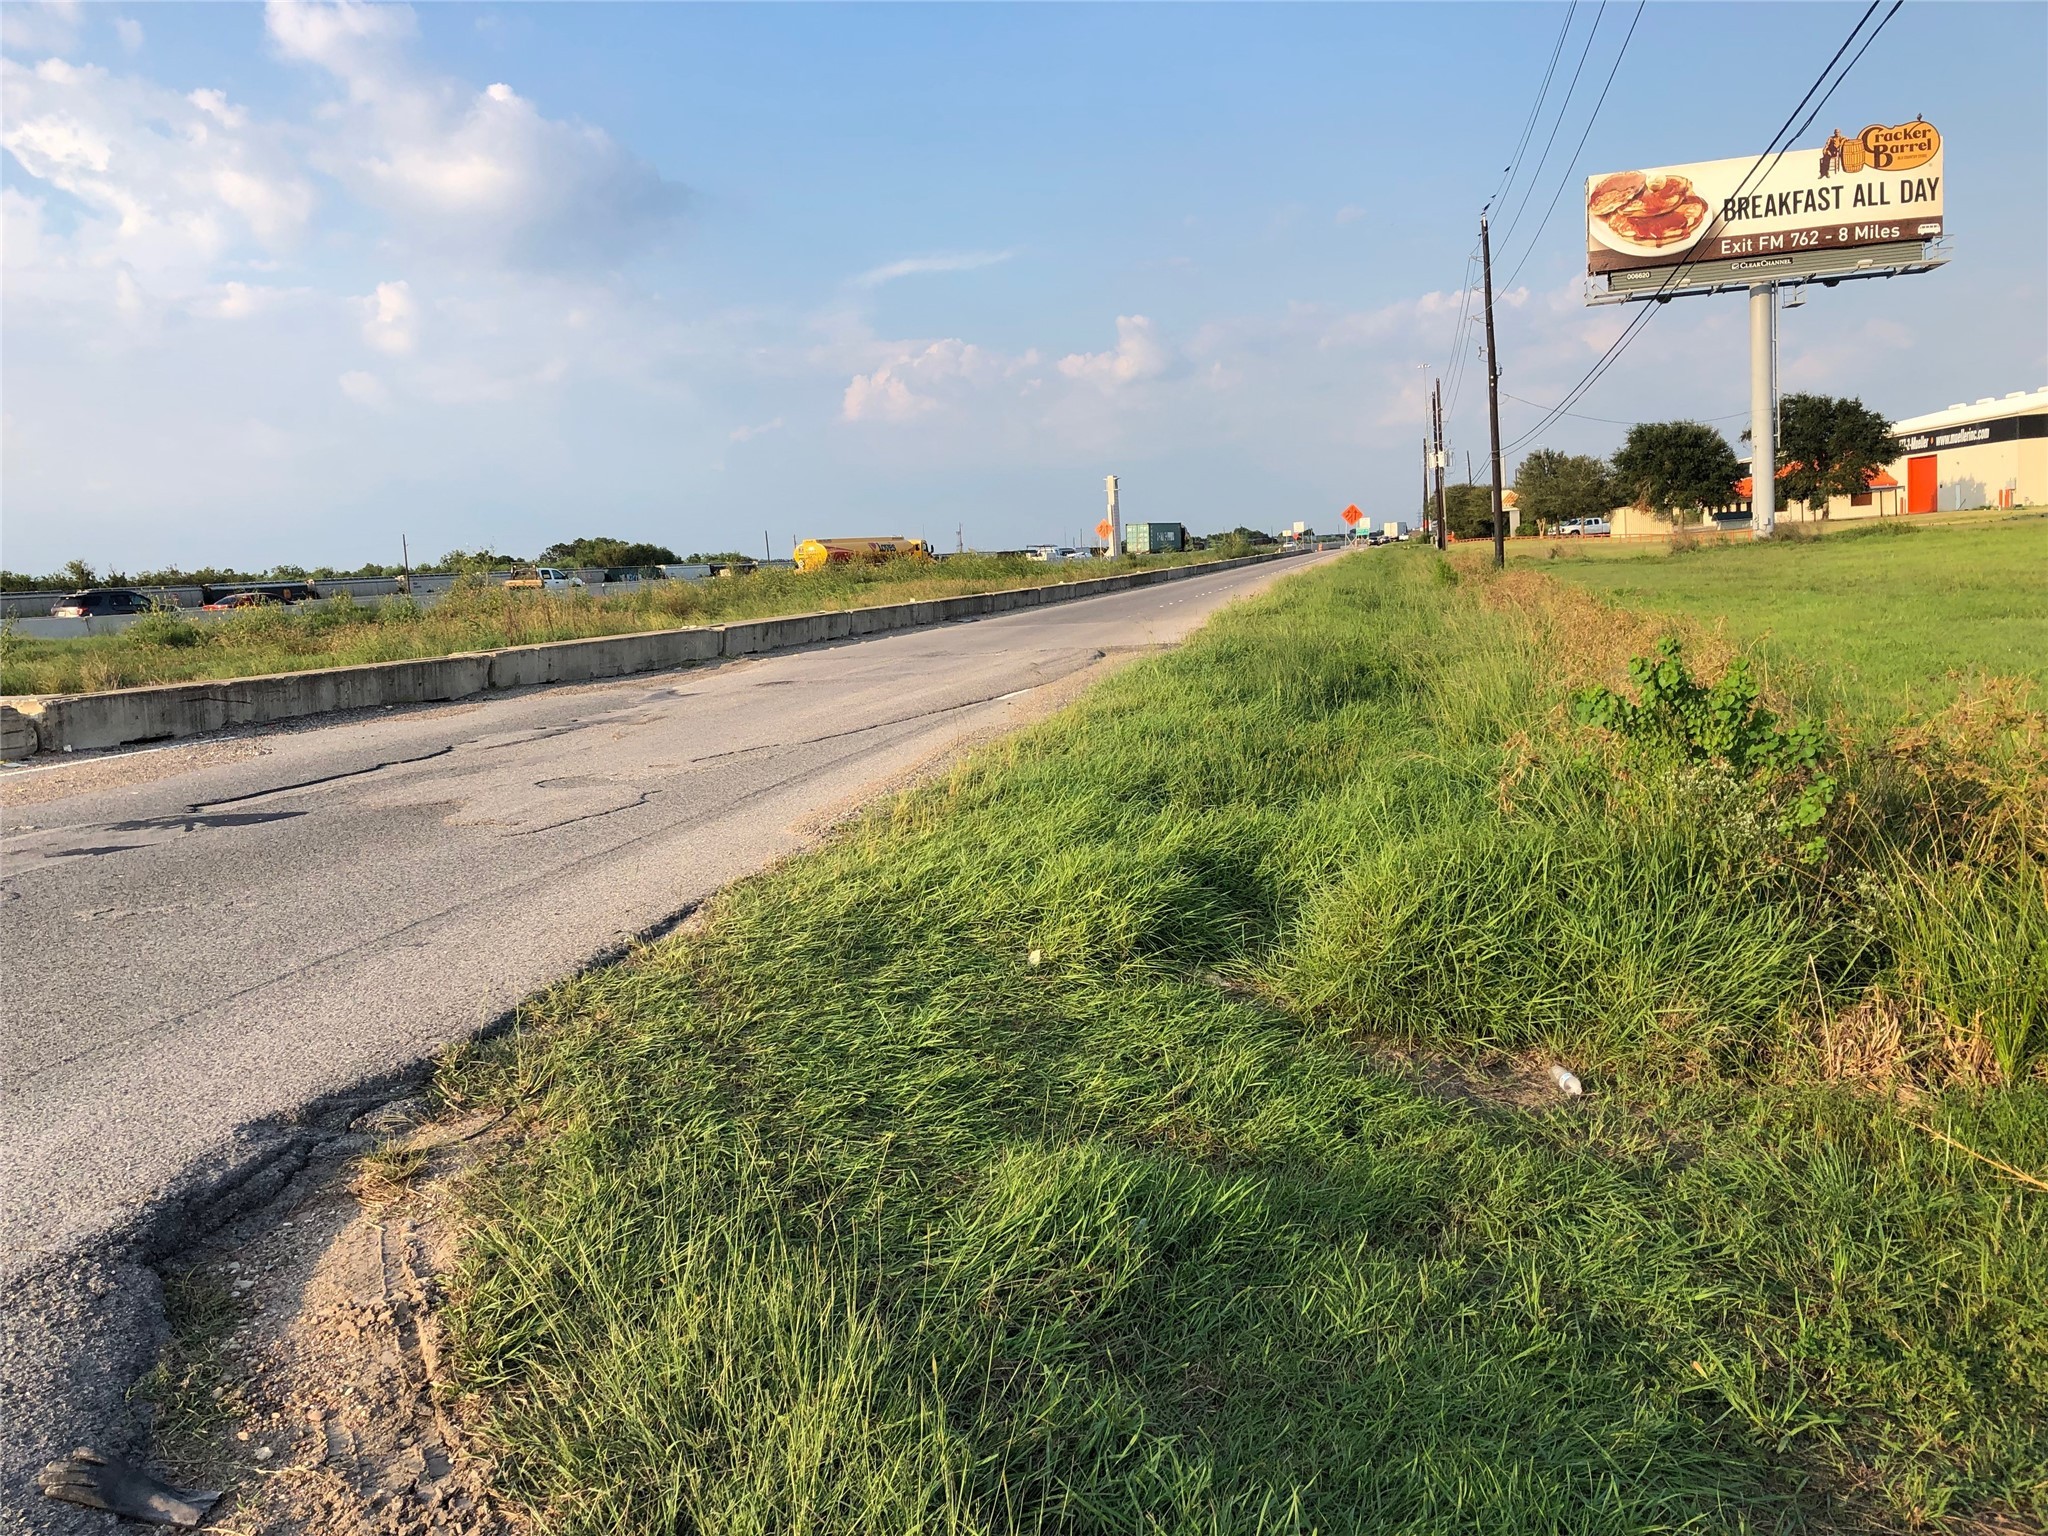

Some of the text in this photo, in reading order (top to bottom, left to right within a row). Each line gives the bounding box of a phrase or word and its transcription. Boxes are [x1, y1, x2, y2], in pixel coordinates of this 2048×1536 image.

[1861, 126, 1932, 154] Cracker
[1873, 138, 1932, 169] Barrel
[1723, 176, 1940, 222] BREAKFAST ALL DAY
[1720, 238, 1753, 255] Exit
[1759, 234, 1784, 251] FM
[1790, 230, 1819, 246] 762
[1838, 227, 1849, 242] 8
[1854, 224, 1901, 241] Miles
